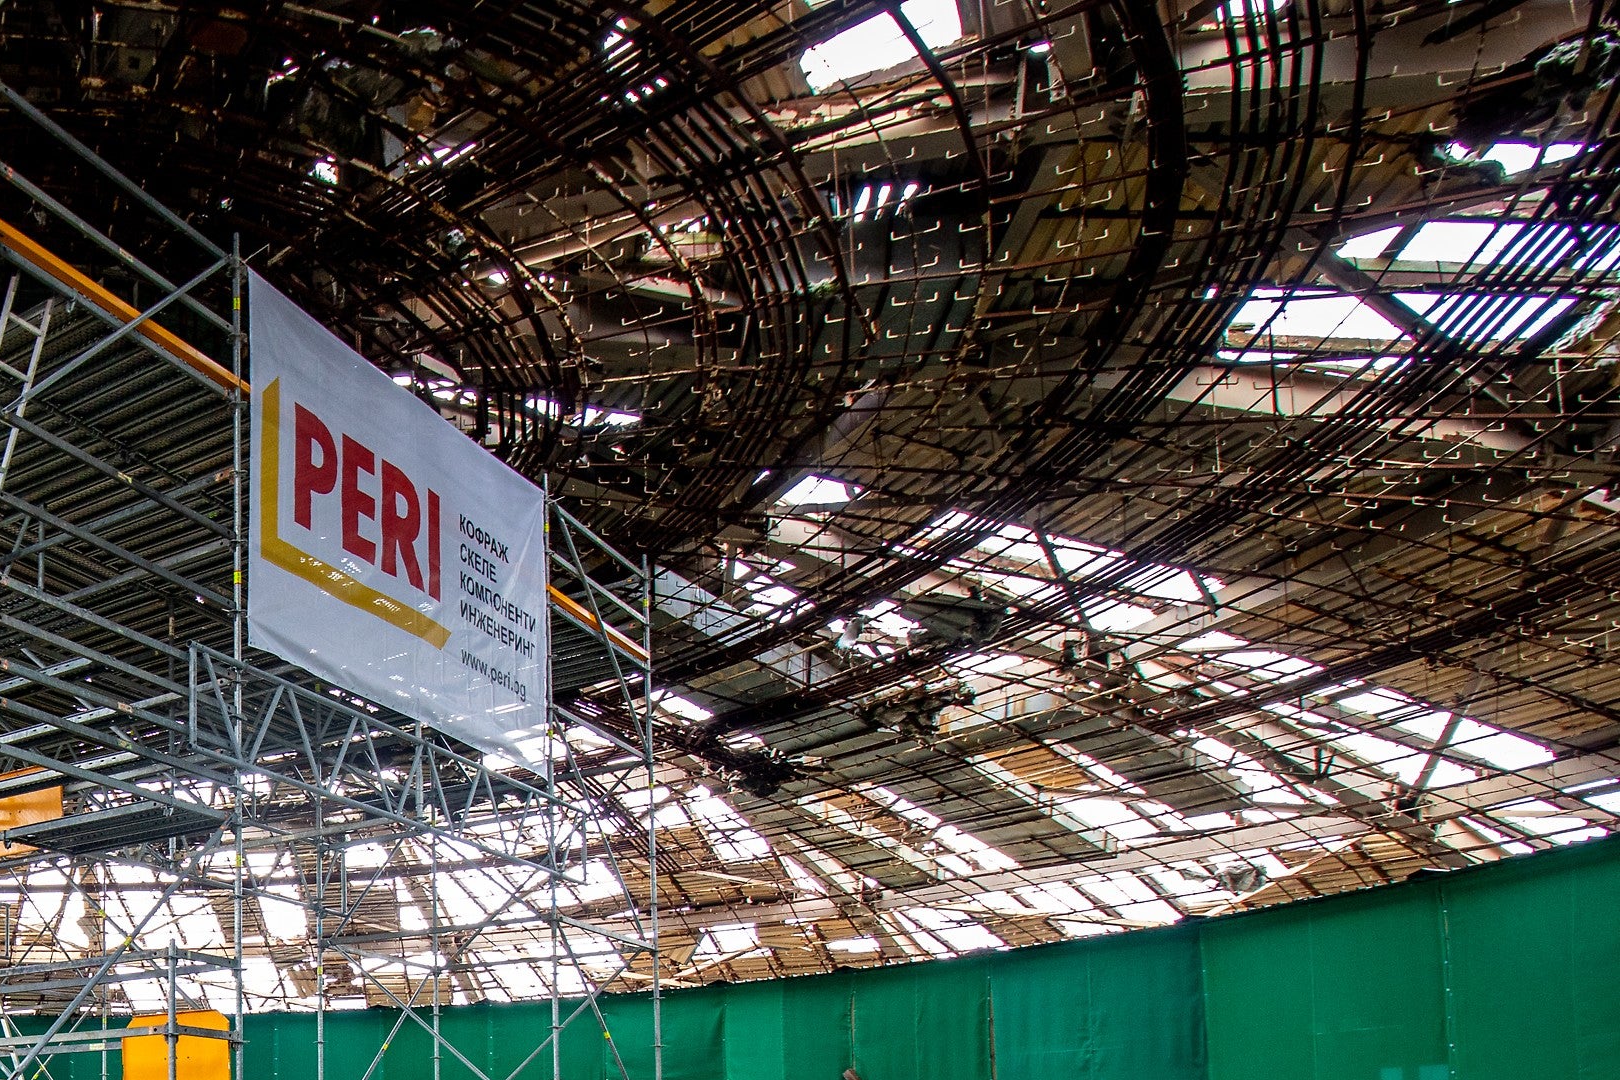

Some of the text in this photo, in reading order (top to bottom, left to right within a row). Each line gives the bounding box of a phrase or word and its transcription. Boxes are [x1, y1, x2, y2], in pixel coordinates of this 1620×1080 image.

[294, 401, 441, 603] PERI
[459, 513, 510, 564] КОФРАЖ
[459, 542, 497, 583] СКЕЛЕ
[459, 570, 536, 633] КОМПОНЕНТИ
[459, 600, 536, 660] ИНЖЕНЕРИНГ
[460, 648, 527, 702] www.peri.bg
